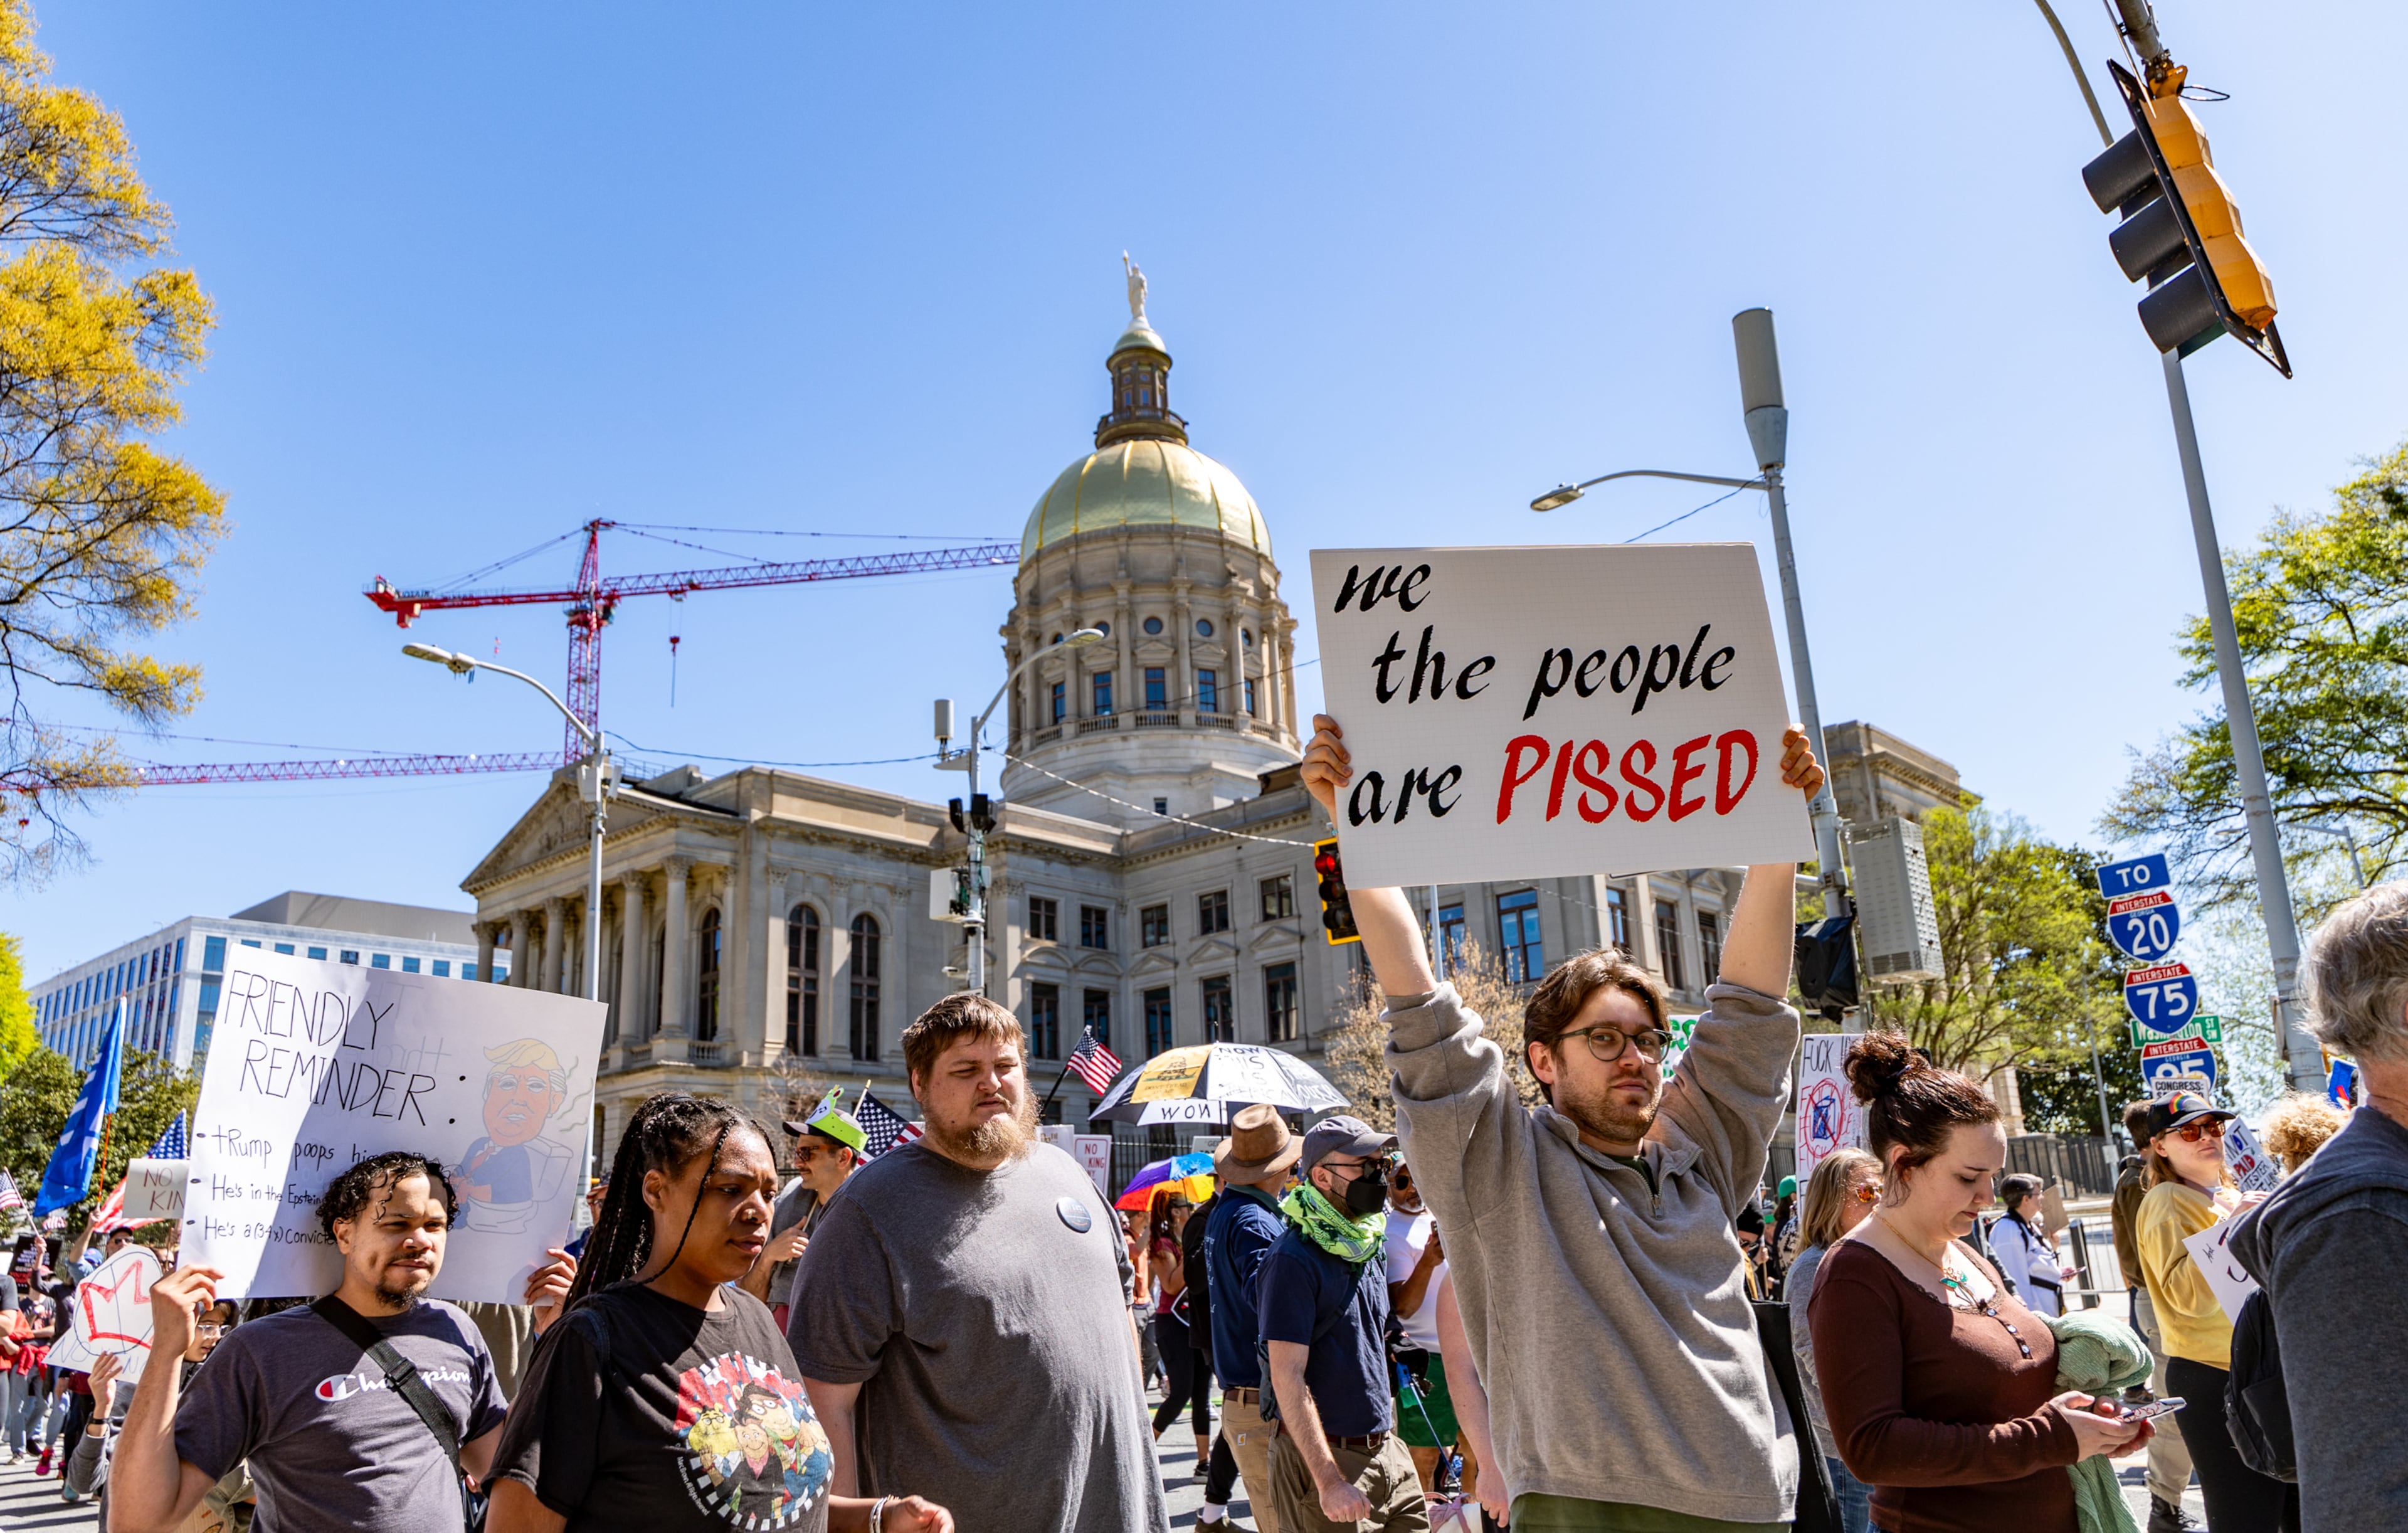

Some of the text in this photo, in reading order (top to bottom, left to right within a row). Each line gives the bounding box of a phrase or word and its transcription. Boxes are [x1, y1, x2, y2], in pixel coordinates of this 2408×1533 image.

[1334, 563, 1431, 614] we
[1371, 624, 1735, 721] the people
[1348, 729, 1759, 827] are PISSED
[2116, 864, 2150, 887] TO
[2115, 894, 2163, 913] INTERSTATE
[2127, 913, 2170, 955] 20
[2132, 966, 2182, 983] INTERSTATE
[224, 970, 394, 1050] FRIENDLY
[2136, 982, 2189, 1019] 75
[2205, 1018, 2215, 1029] ST
[2206, 1029, 2217, 1040] SW
[1802, 1038, 1834, 1078] FUCK
[2149, 1040, 2200, 1056] INTERSTATE
[294, 1142, 335, 1171] poops
[1085, 1144, 1097, 1155] NO
[1089, 1157, 1105, 1169] KING
[144, 1168, 172, 1187] NO
[212, 1173, 321, 1209] He's in the Epstein
[150, 1191, 184, 1211] KIN
[204, 1215, 235, 1241] He's
[244, 1224, 251, 1238] a
[286, 1229, 337, 1245] Convicte
[48, 1337, 91, 1364] NO
